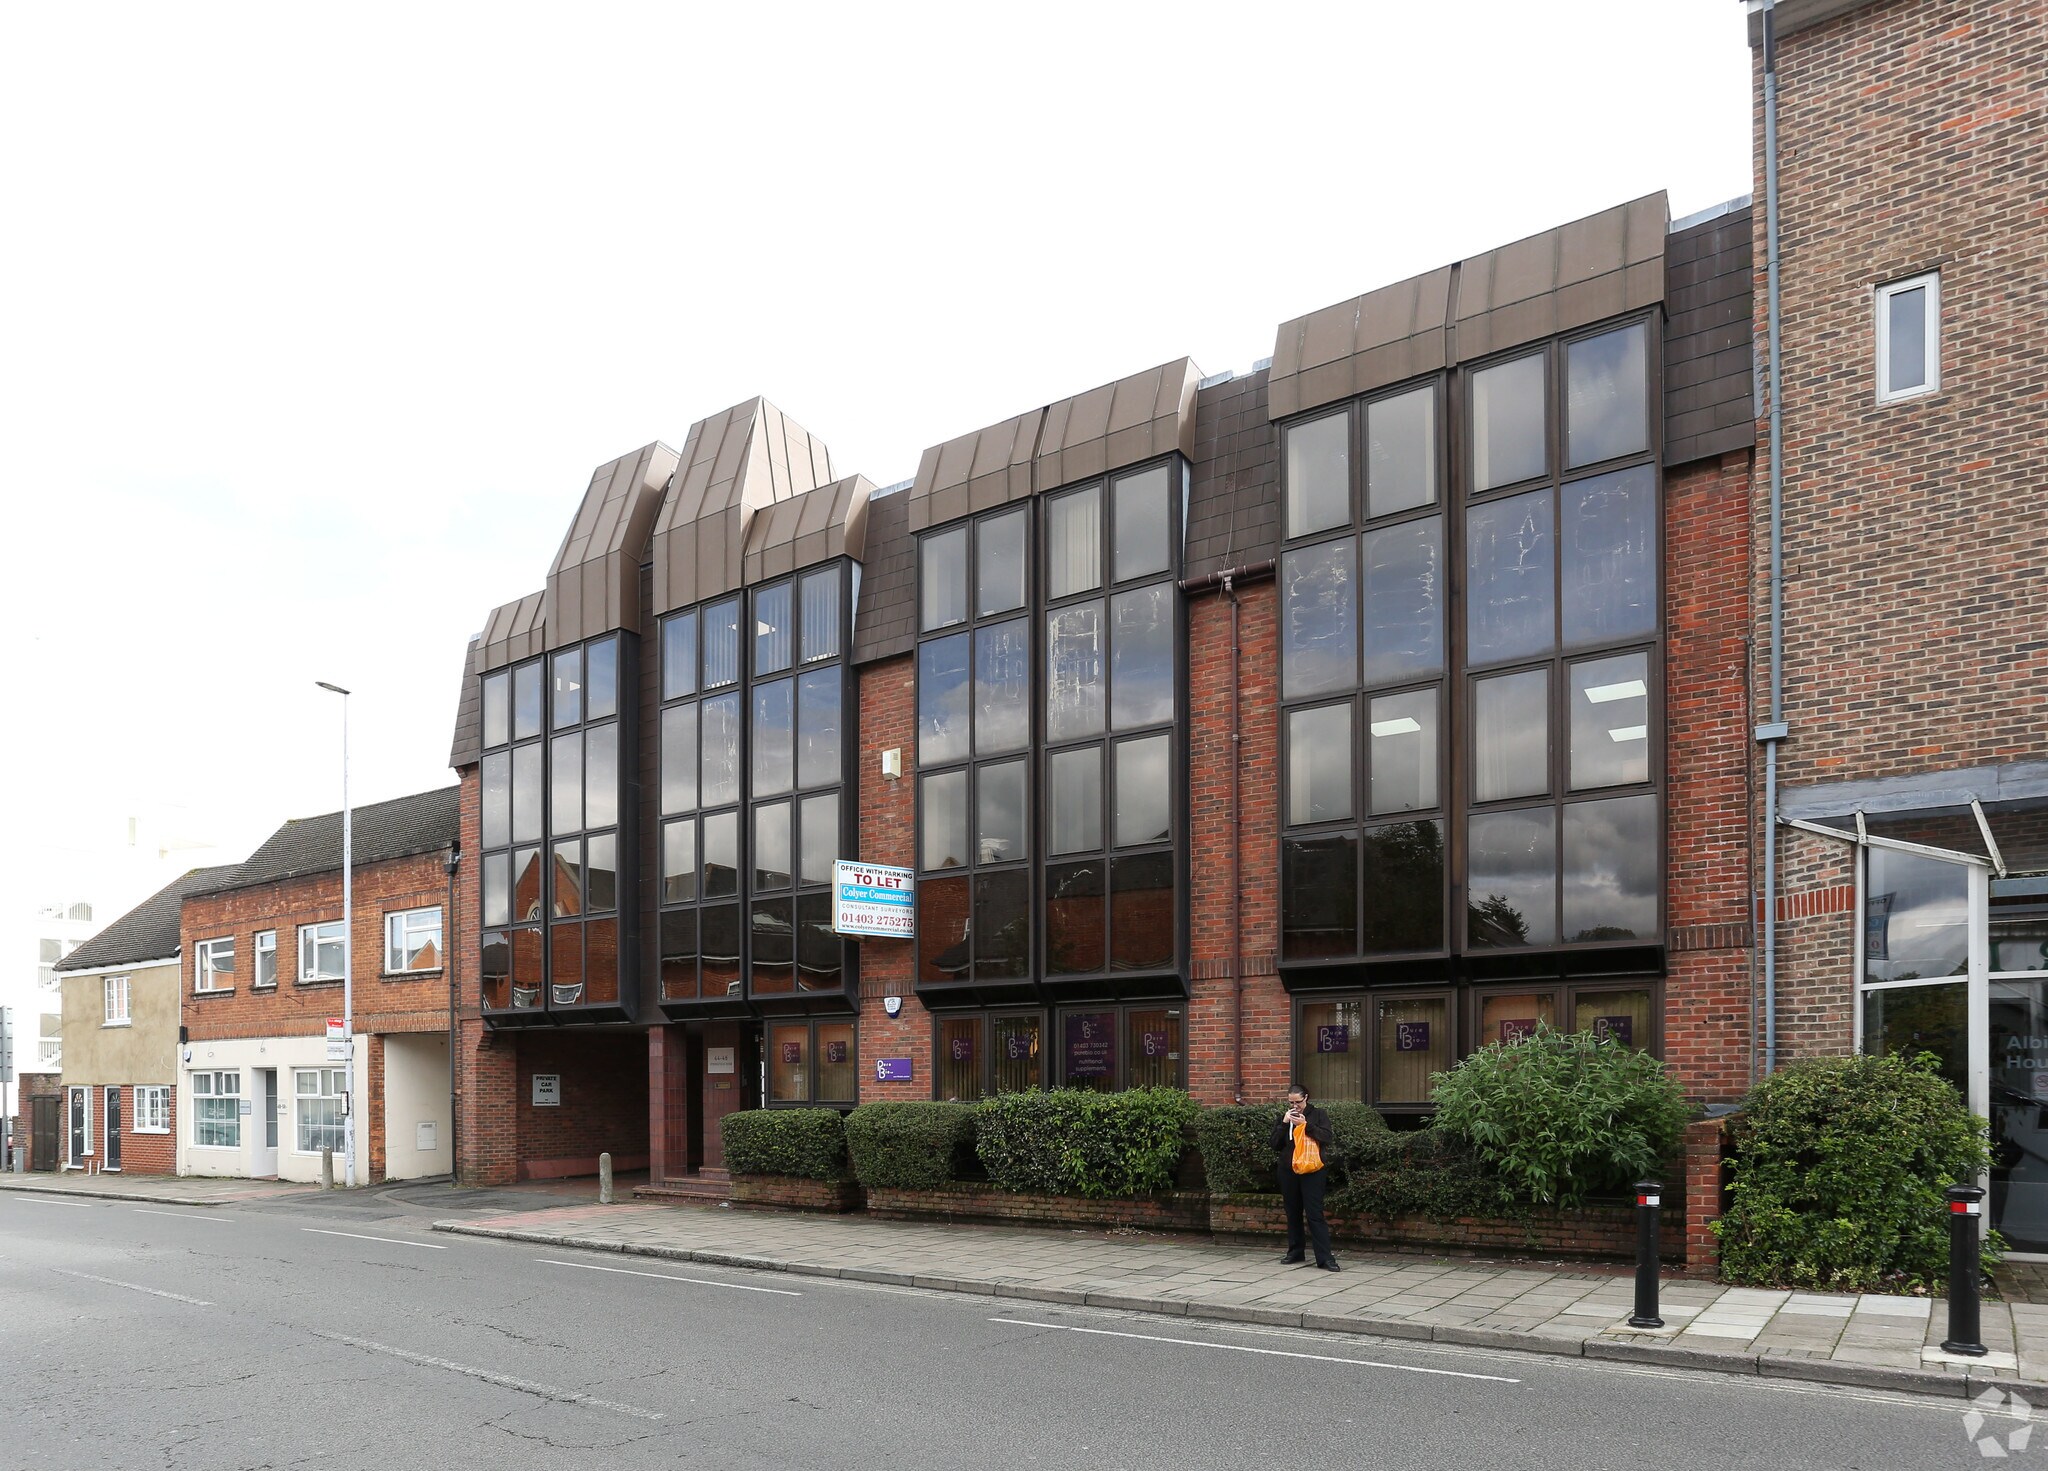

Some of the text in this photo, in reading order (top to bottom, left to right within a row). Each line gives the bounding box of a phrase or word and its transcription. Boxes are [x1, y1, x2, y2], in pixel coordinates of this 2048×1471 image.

[841, 864, 864, 873] OFFICE
[884, 870, 913, 879] PARKING
[854, 873, 902, 888] TO LET
[842, 886, 912, 902] Colyer Commercial
[841, 903, 913, 915] CONSULTANT SURVEYORS
[841, 912, 913, 927] 01403 275275
[1320, 1027, 1342, 1042] Pure
[1399, 1025, 1423, 1040] Pure
